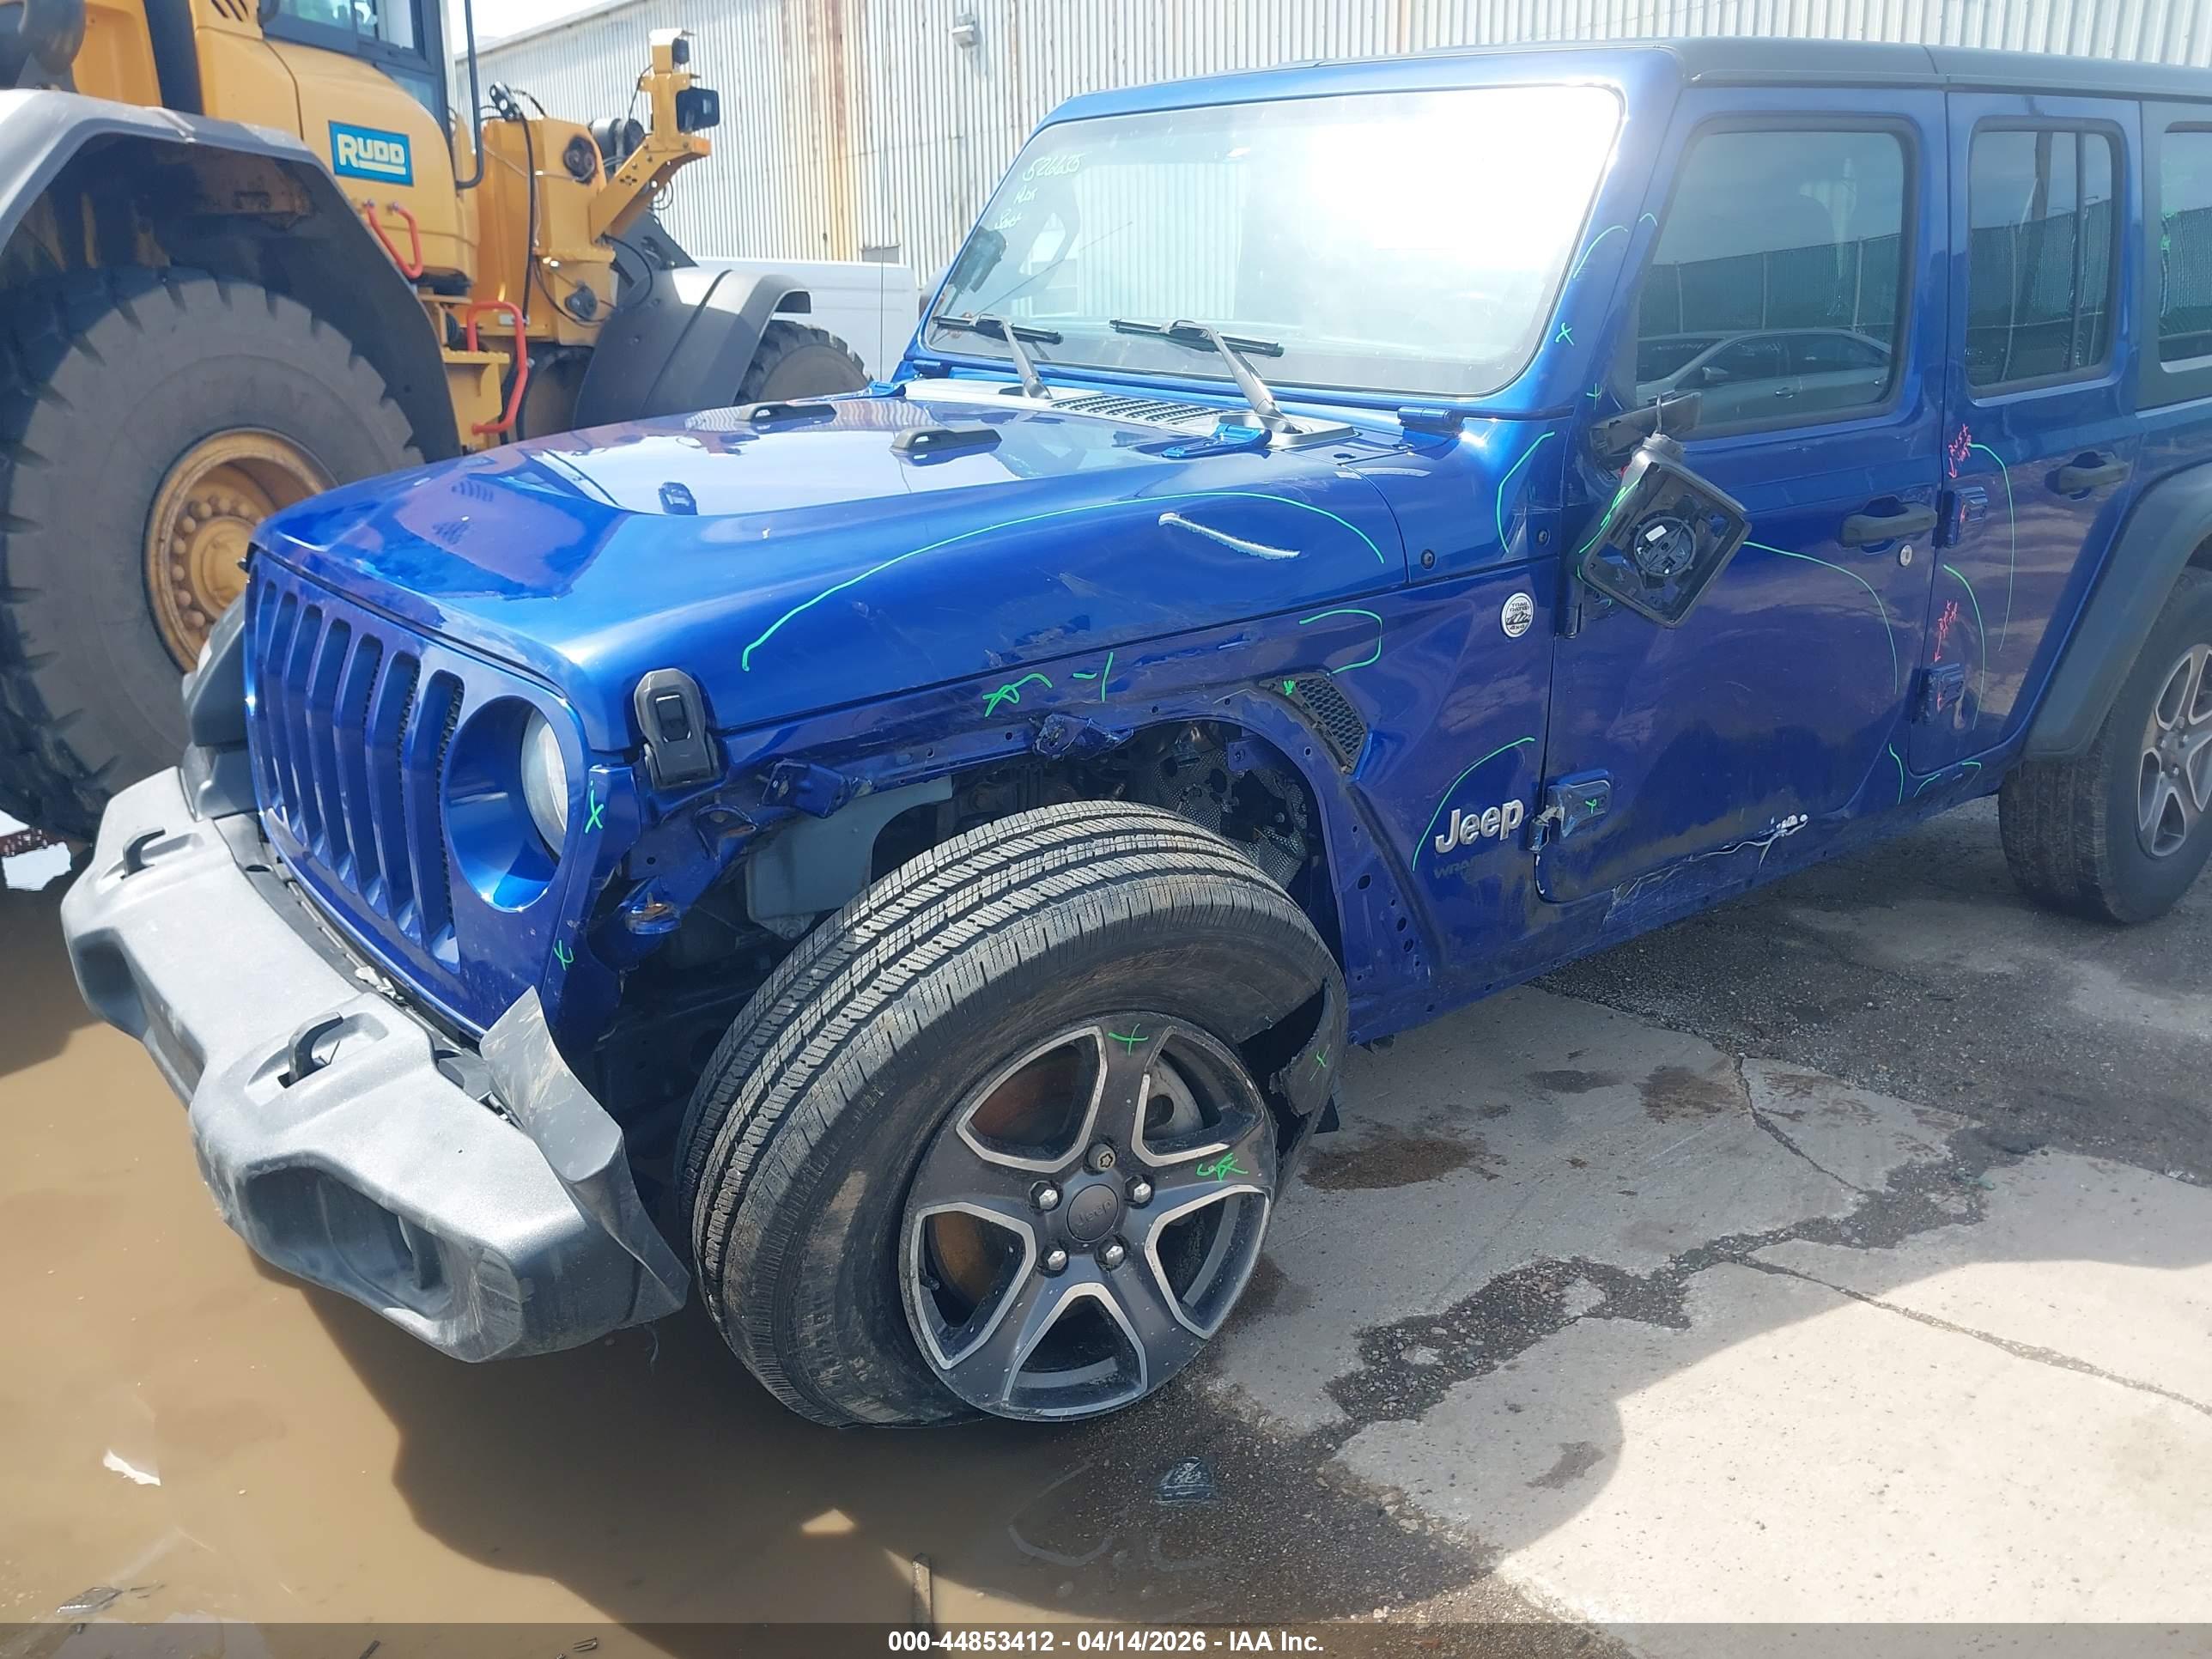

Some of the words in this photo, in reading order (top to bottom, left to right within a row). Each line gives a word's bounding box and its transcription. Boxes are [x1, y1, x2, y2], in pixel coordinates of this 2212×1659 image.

[337, 133, 405, 169] RUDD
[1435, 799, 1524, 854] Jeep
[1075, 1198, 1113, 1227] Jeep
